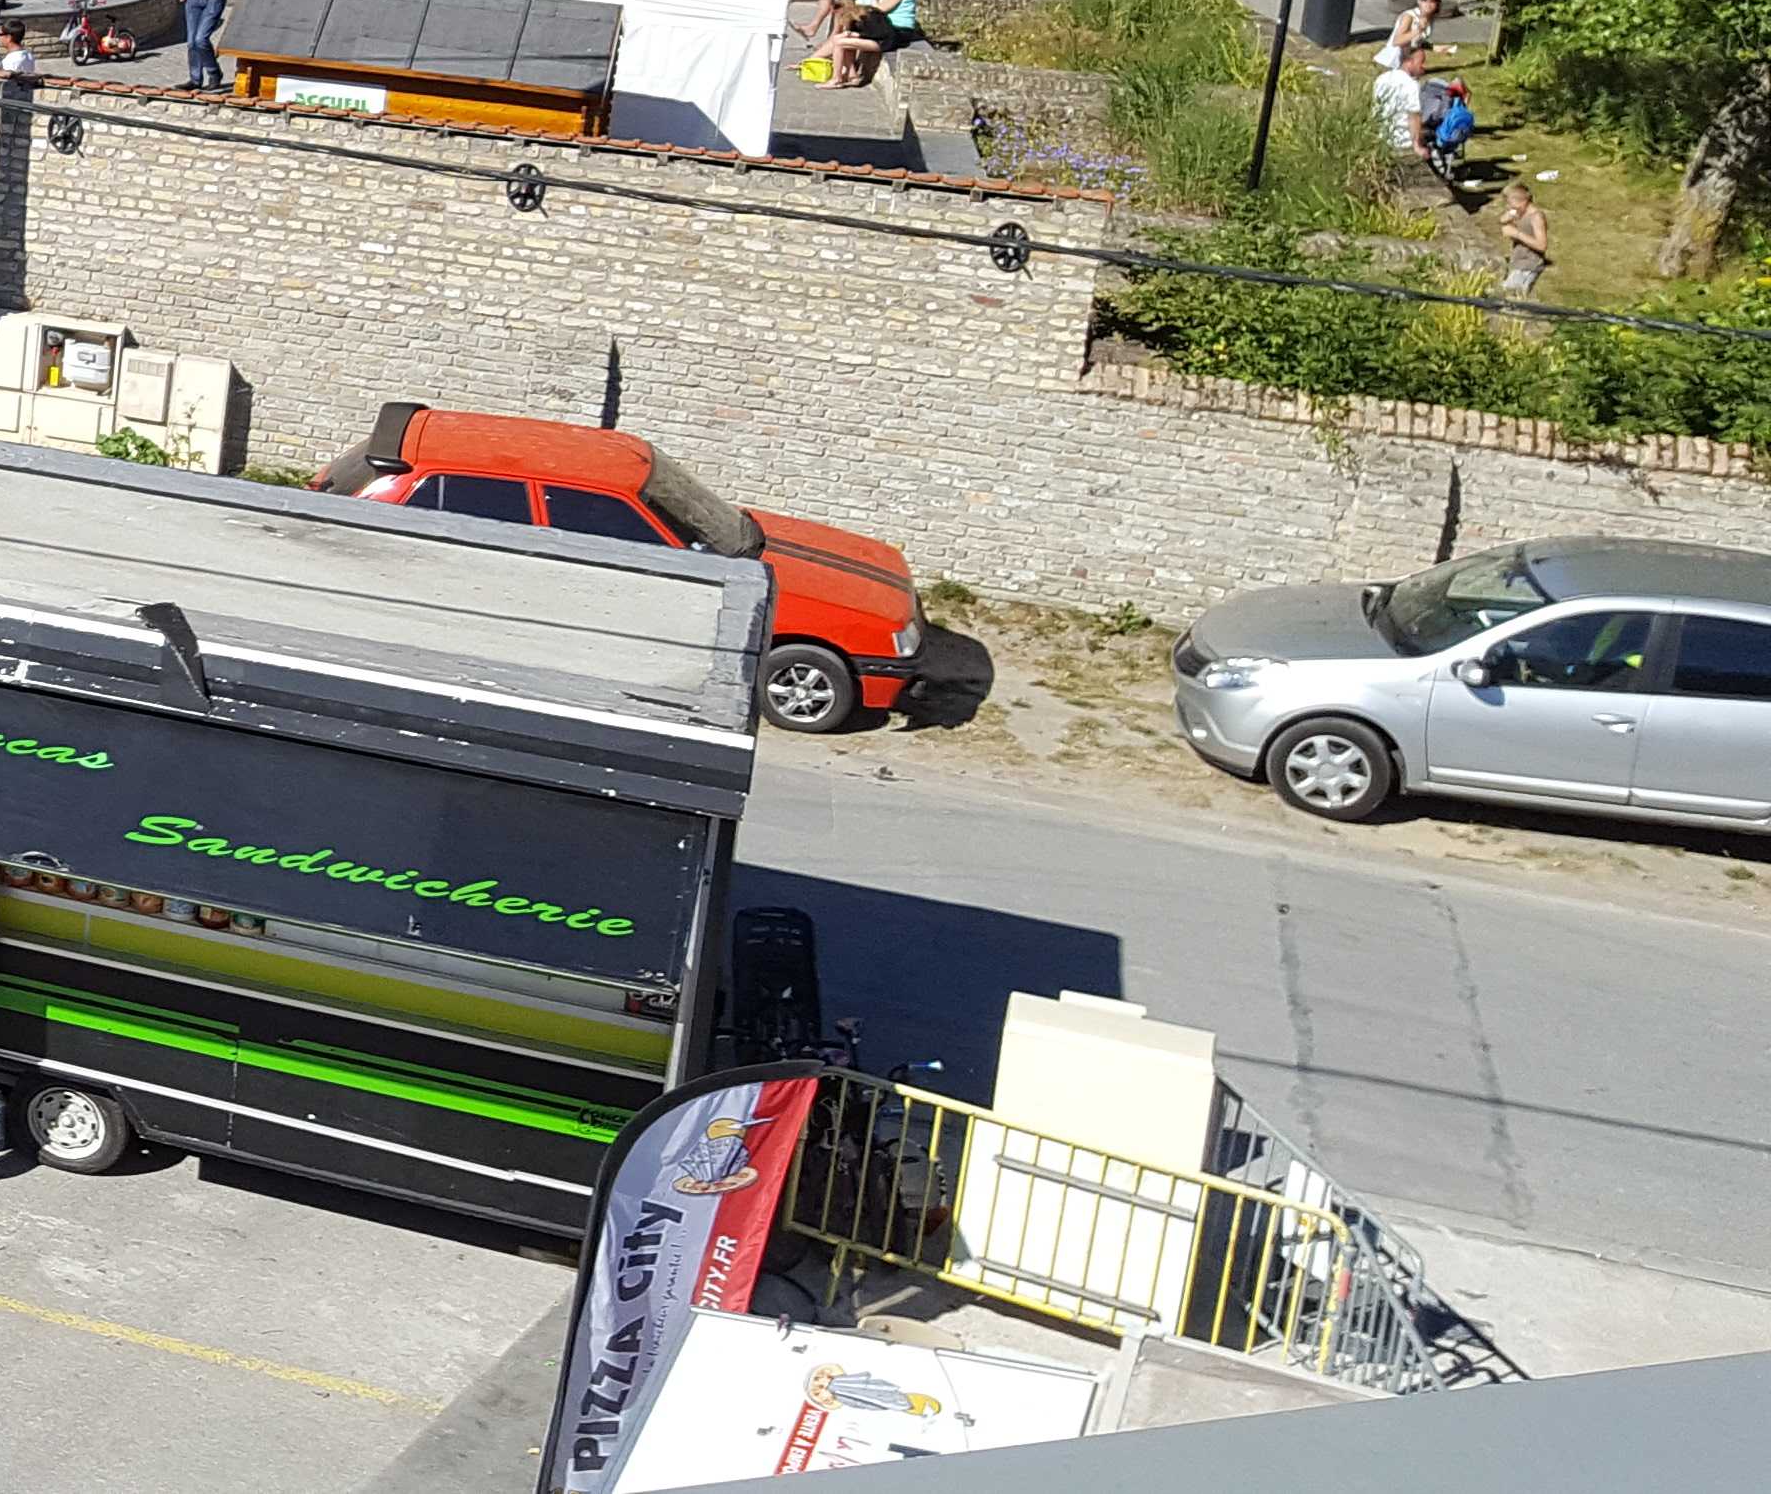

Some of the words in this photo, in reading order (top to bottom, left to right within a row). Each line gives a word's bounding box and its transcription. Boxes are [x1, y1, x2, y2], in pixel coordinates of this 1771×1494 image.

[295, 92, 370, 113] ACCUEIL
[125, 815, 635, 936] Sandwicherie
[572, 1315, 646, 1473] PIZZA
[616, 1200, 685, 1302] City
[797, 1408, 823, 1440] VENTE
